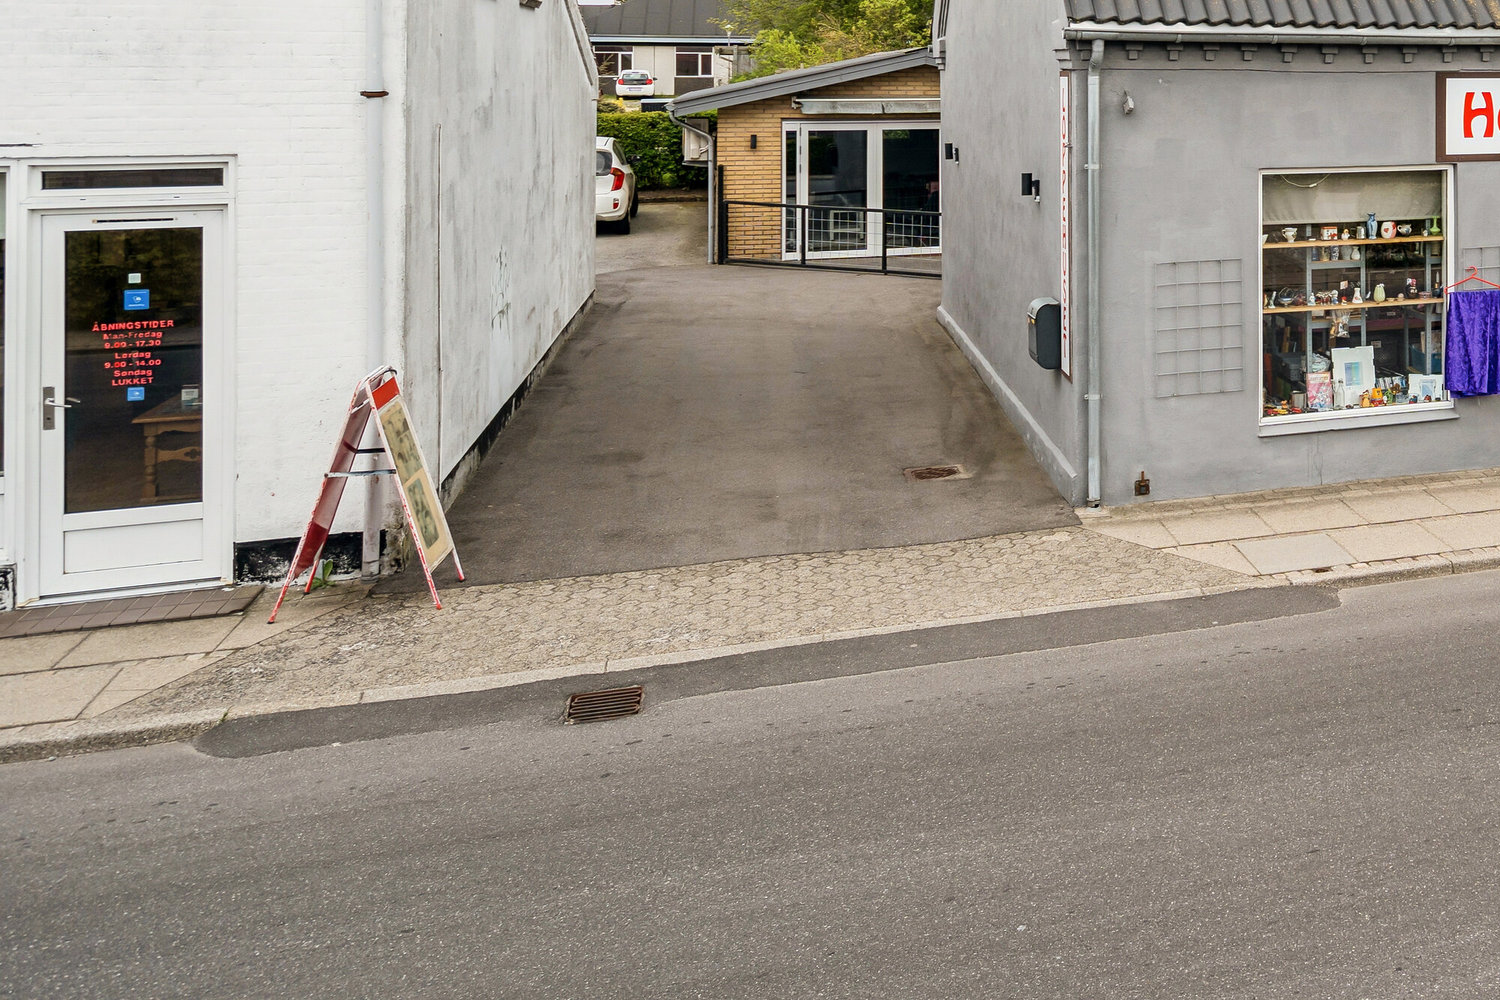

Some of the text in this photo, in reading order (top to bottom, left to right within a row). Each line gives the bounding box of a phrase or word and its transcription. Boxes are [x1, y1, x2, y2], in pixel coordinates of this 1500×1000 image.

[92, 320, 175, 332] ÅBNINGSTIDER
[103, 331, 163, 340] Man-Fredag
[104, 361, 127, 369] 9.00
[112, 377, 154, 386] LUKKET
